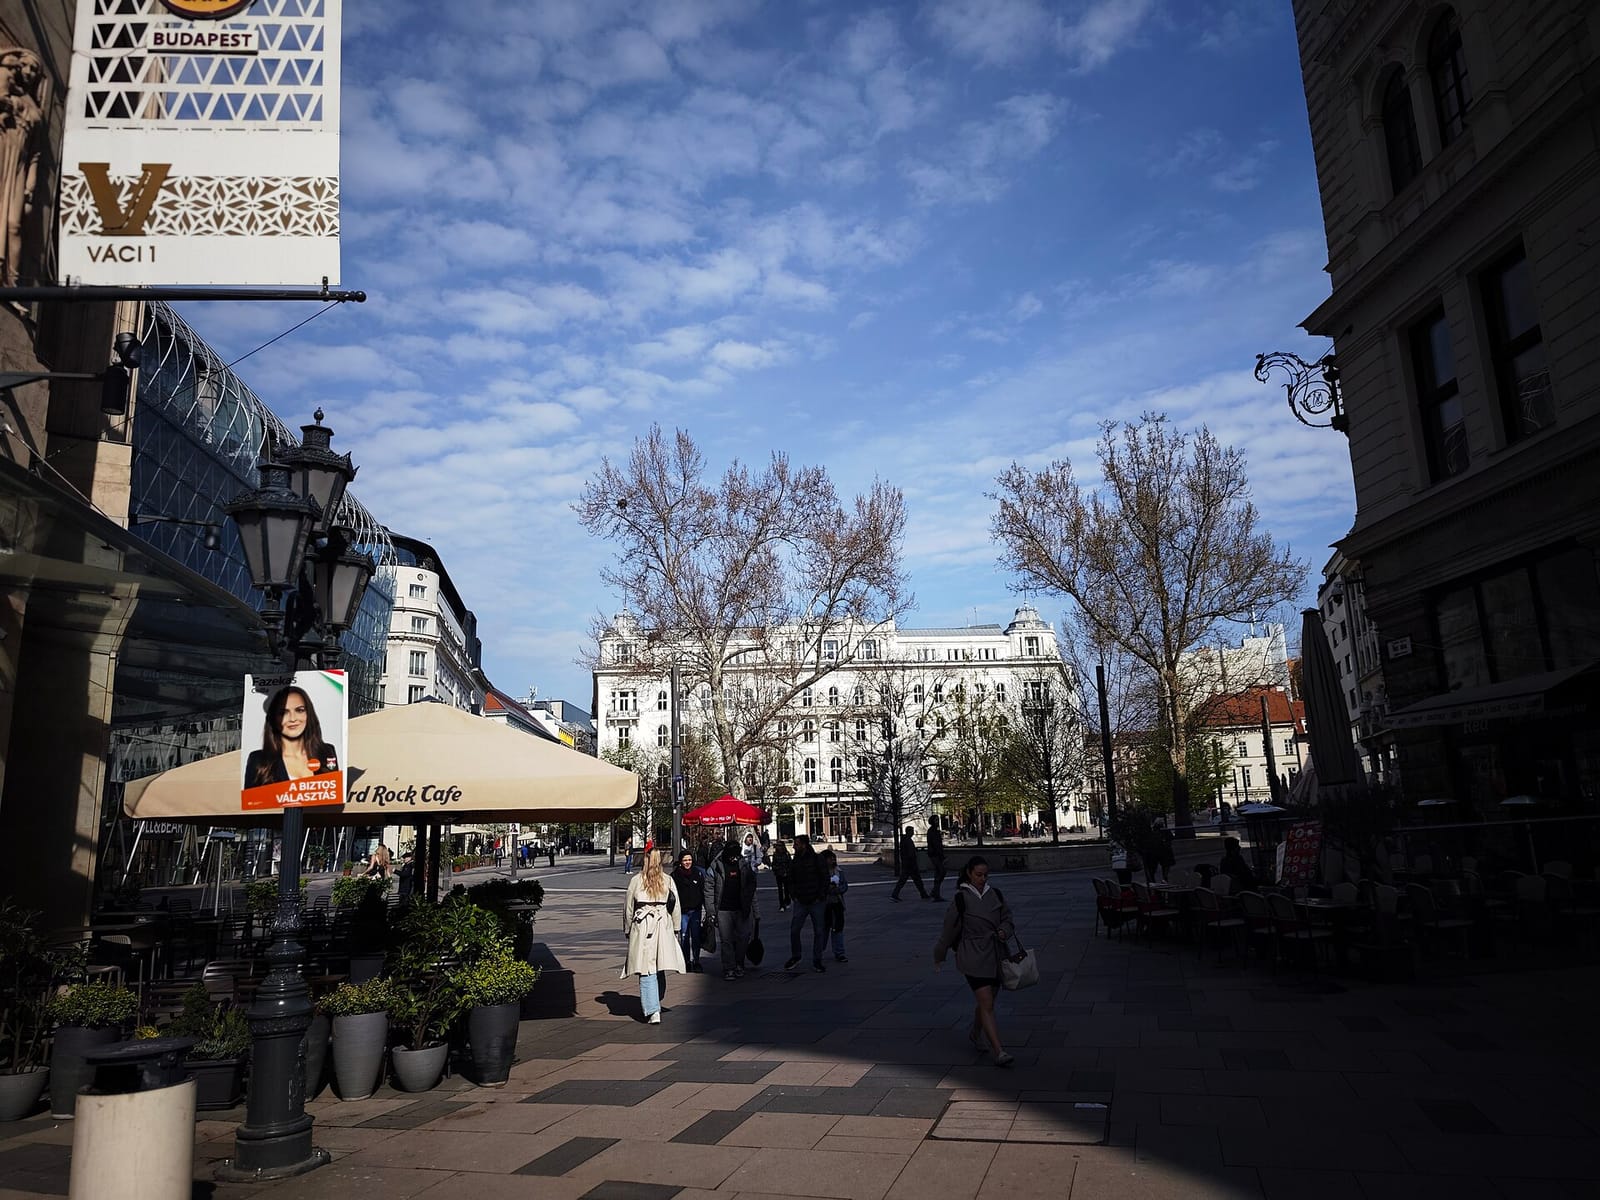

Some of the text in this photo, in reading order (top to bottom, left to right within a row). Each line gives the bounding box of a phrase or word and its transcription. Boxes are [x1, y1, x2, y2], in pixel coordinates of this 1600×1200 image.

[153, 32, 253, 47] BUDAPEST
[87, 243, 156, 263] VÁCI 1
[252, 676, 297, 687] Fazekas
[289, 780, 336, 791] A BIZTOS
[275, 789, 336, 803] VÁLASZTÁS
[347, 784, 462, 806] rd Rock Cafe
